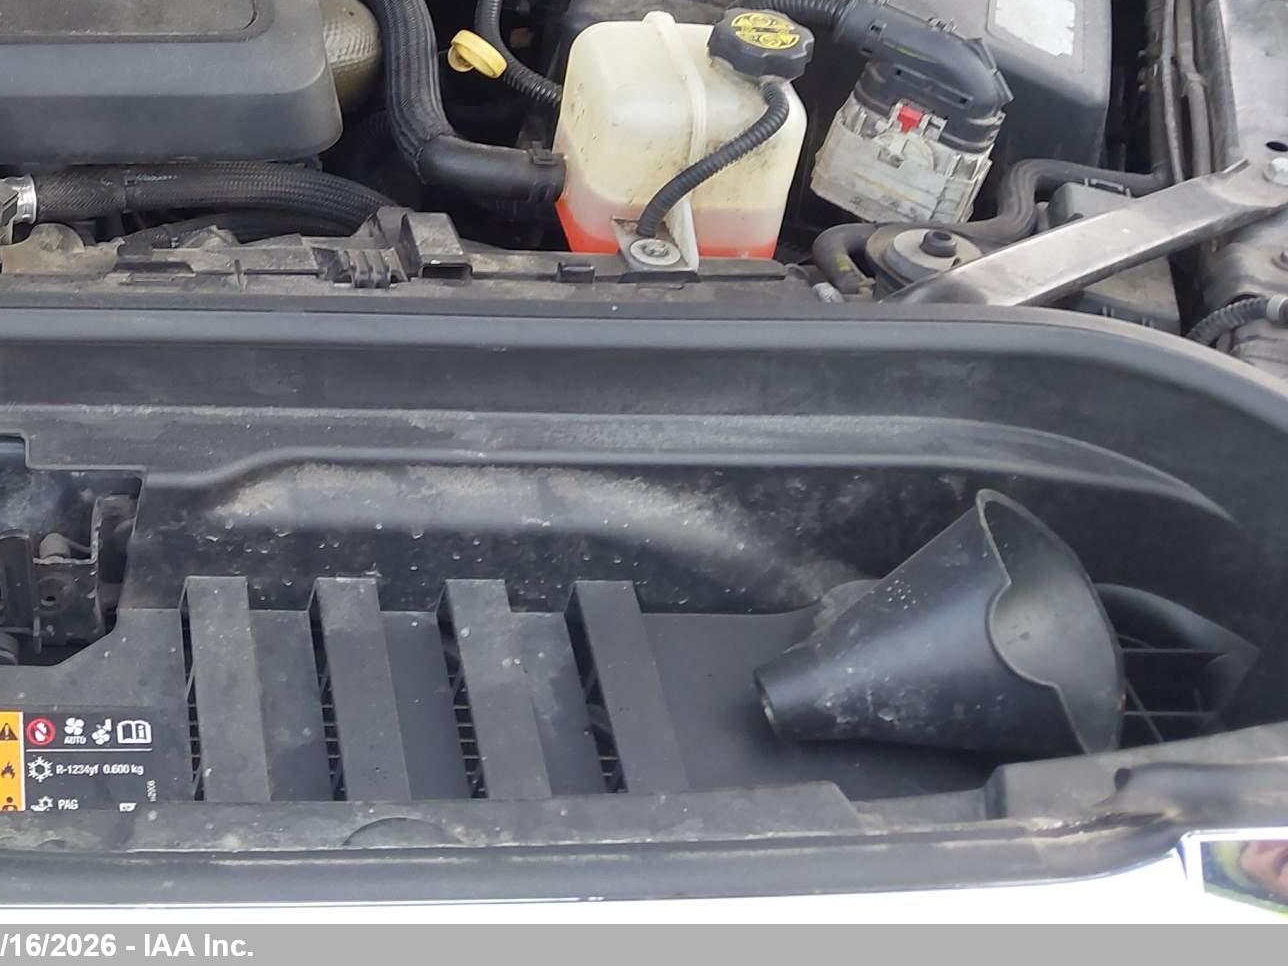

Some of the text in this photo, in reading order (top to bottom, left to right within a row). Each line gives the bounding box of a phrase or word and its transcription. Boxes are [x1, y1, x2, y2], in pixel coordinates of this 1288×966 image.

[64, 736, 87, 745] AUTO
[131, 765, 144, 777] kg
[58, 799, 79, 811] PAG
